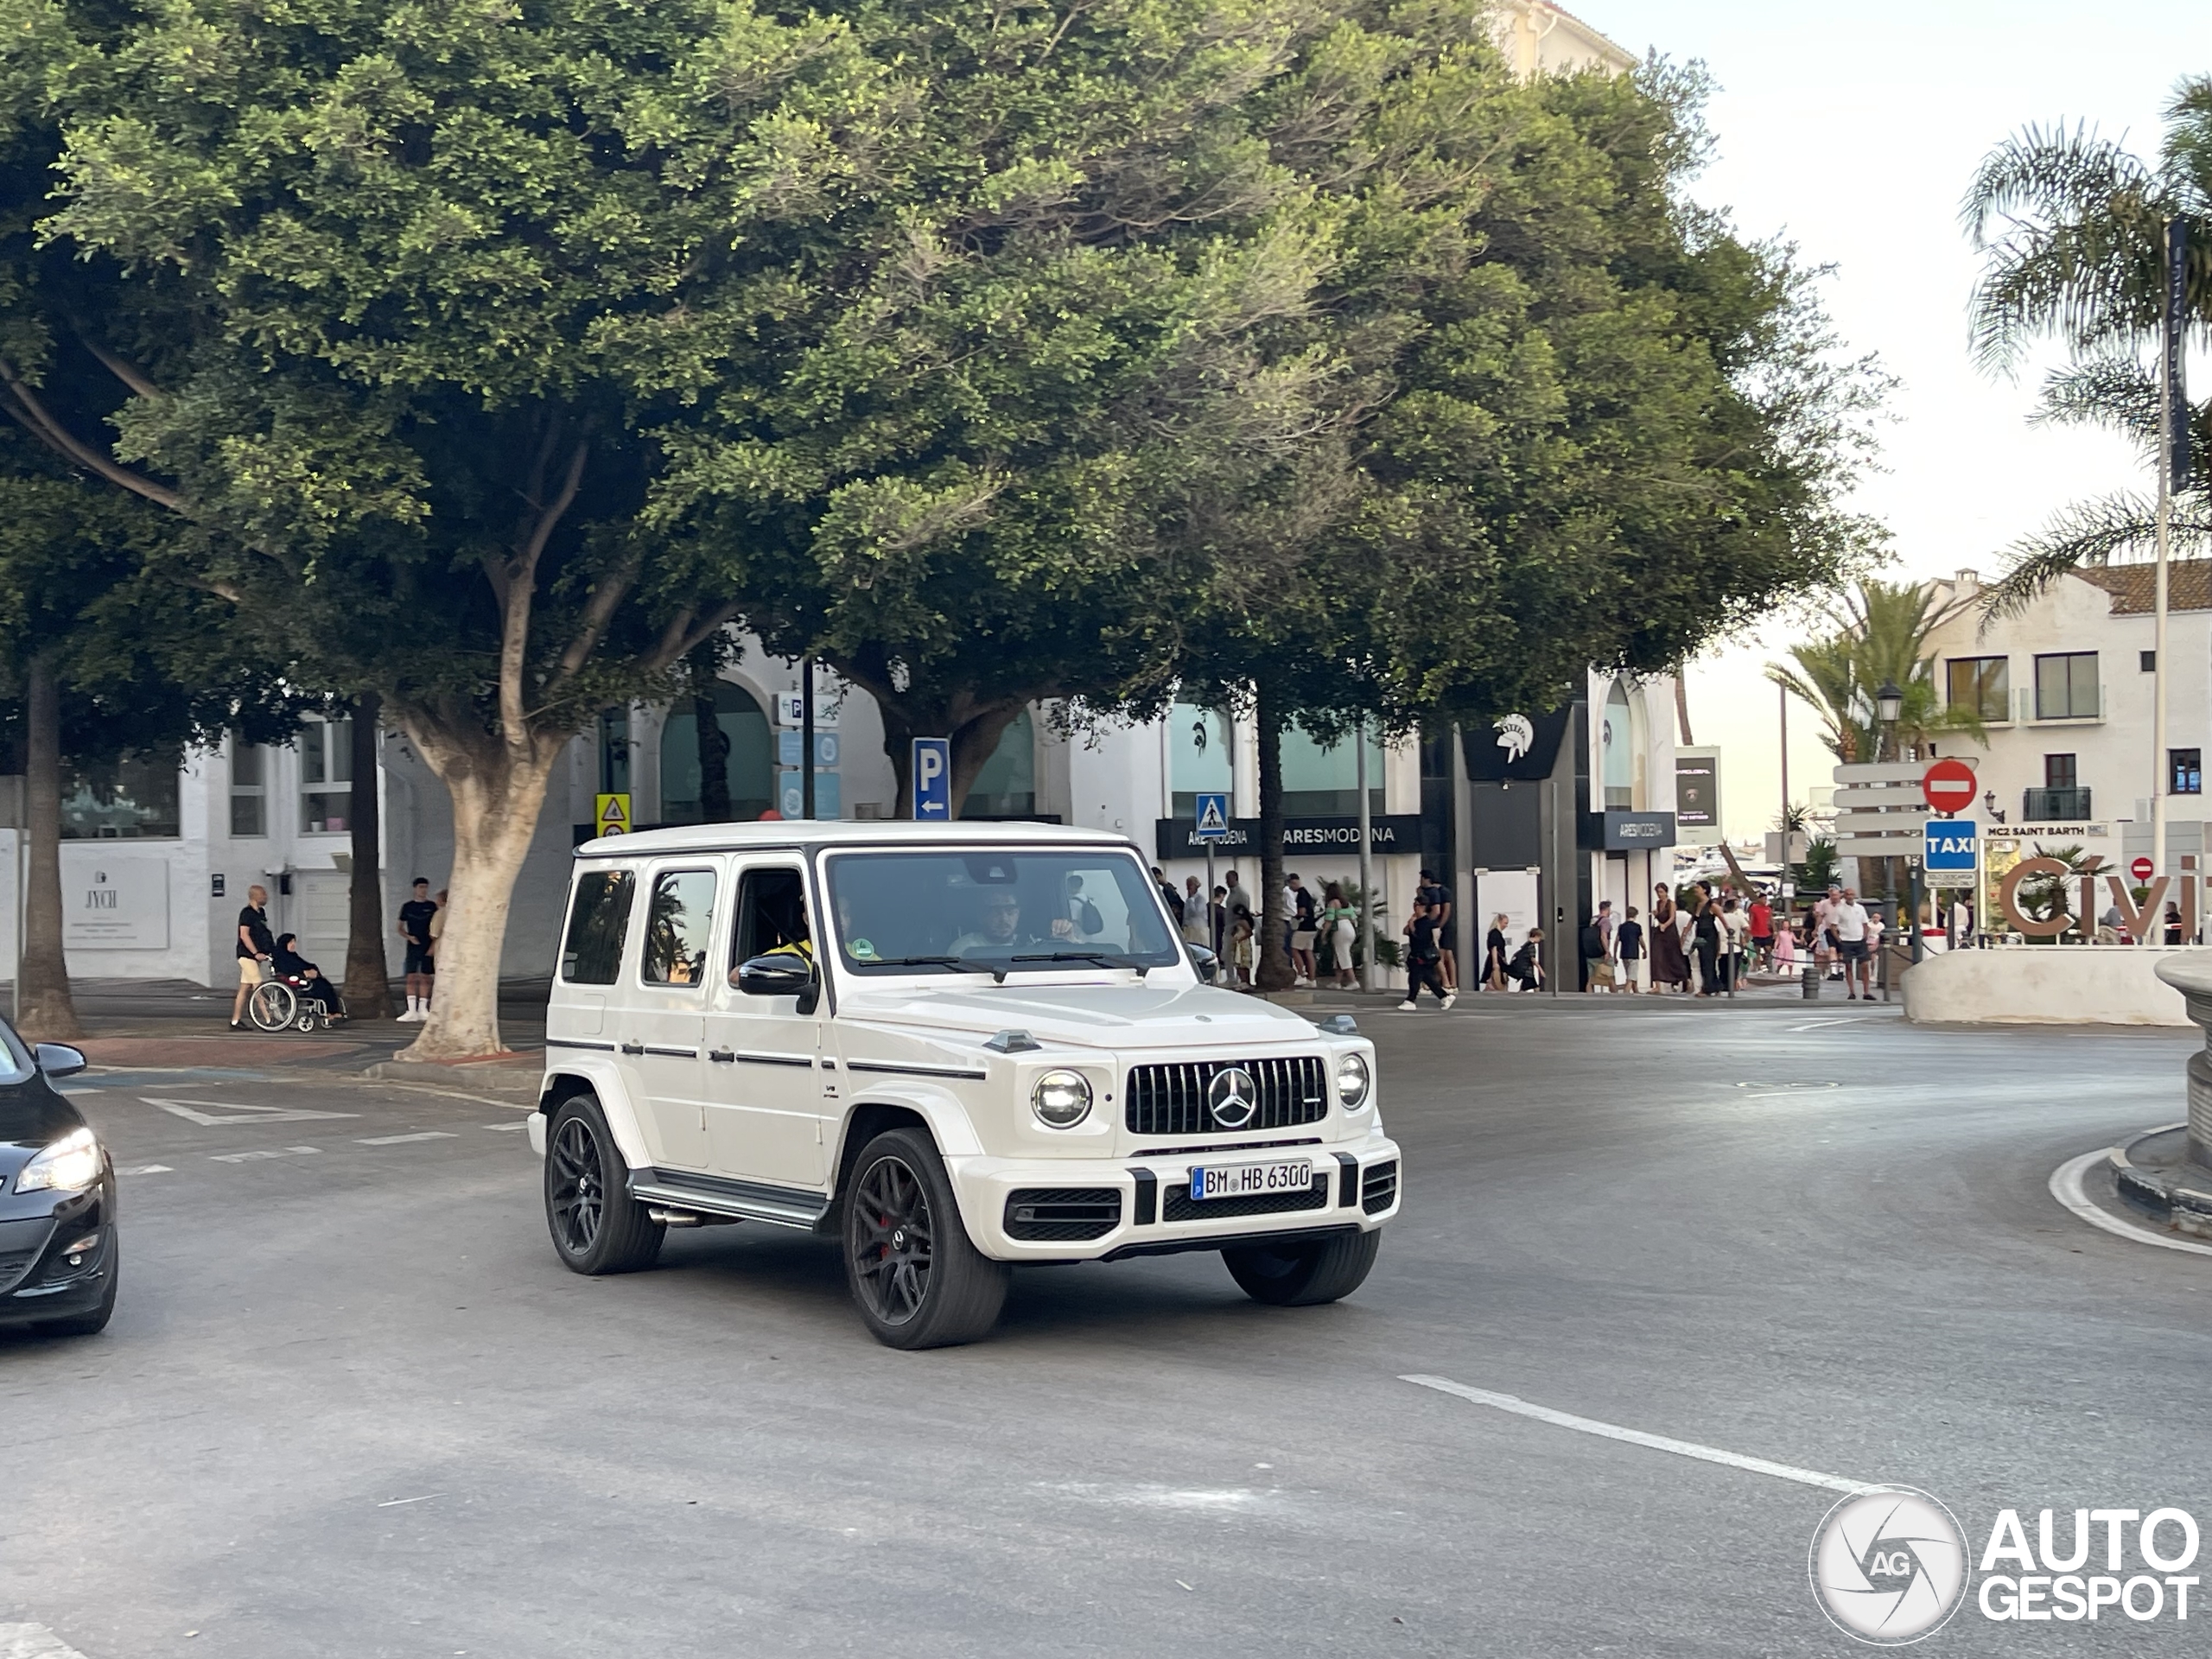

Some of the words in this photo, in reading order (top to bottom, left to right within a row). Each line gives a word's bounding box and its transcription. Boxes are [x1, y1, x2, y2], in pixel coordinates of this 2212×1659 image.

[793, 702, 801, 716] P
[920, 748, 943, 791] P
[1282, 827, 1395, 843] ARESMODNA
[1987, 827, 2011, 836] MC2
[2012, 827, 2044, 836] SAINT
[2047, 826, 2084, 836] BARTH
[1926, 836, 1976, 854] TAXI
[1999, 855, 2212, 937] Cívi
[1205, 1170, 1228, 1193] BM
[1241, 1167, 1262, 1191] HB
[1268, 1164, 1310, 1188] 6300
